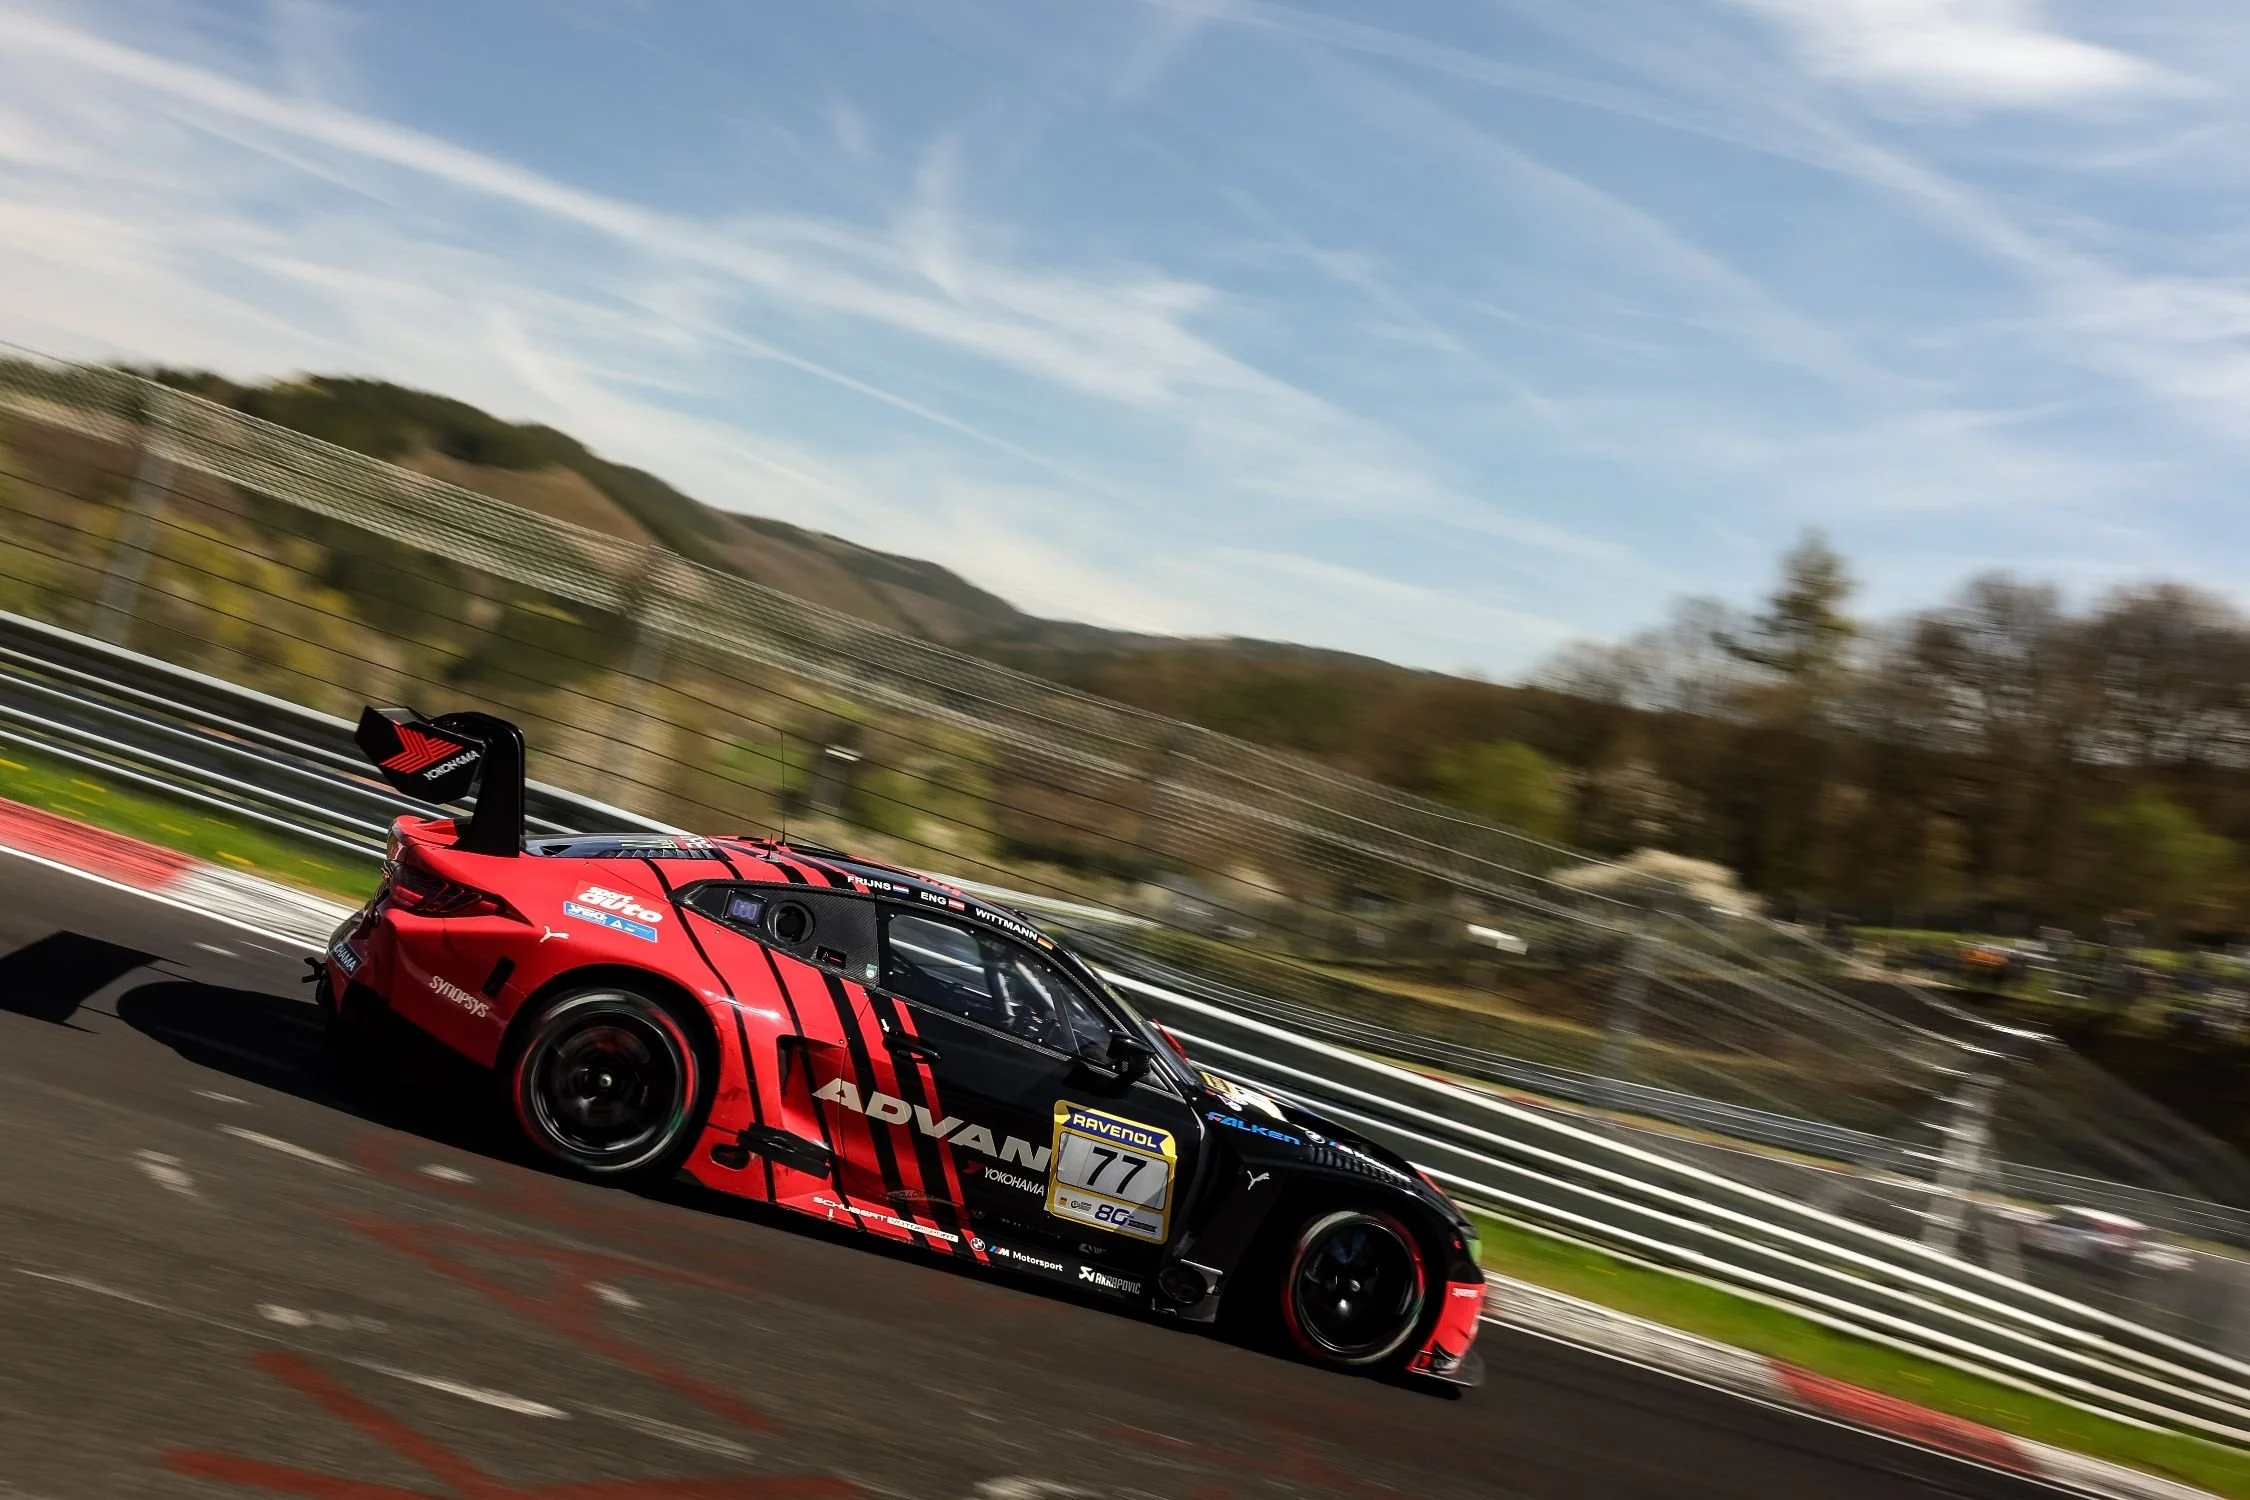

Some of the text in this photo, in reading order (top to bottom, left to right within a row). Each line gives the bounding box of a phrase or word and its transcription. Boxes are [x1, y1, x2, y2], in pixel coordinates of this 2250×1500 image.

[423, 750, 480, 780] YOKOHAMA
[847, 875, 891, 891] FRIJNS
[920, 891, 947, 905] ENG
[577, 892, 663, 923] auto
[975, 907, 1038, 941] WITTMANN
[812, 1077, 1052, 1172] ADVAN
[1072, 1113, 1158, 1148] RAVENOL
[1205, 1111, 1301, 1145] FALKEN
[984, 1166, 1045, 1196] YOKOHAMA
[1086, 1146, 1148, 1194] 77
[813, 1196, 888, 1222] SCHUBERT
[1012, 1250, 1064, 1272] Motorsport
